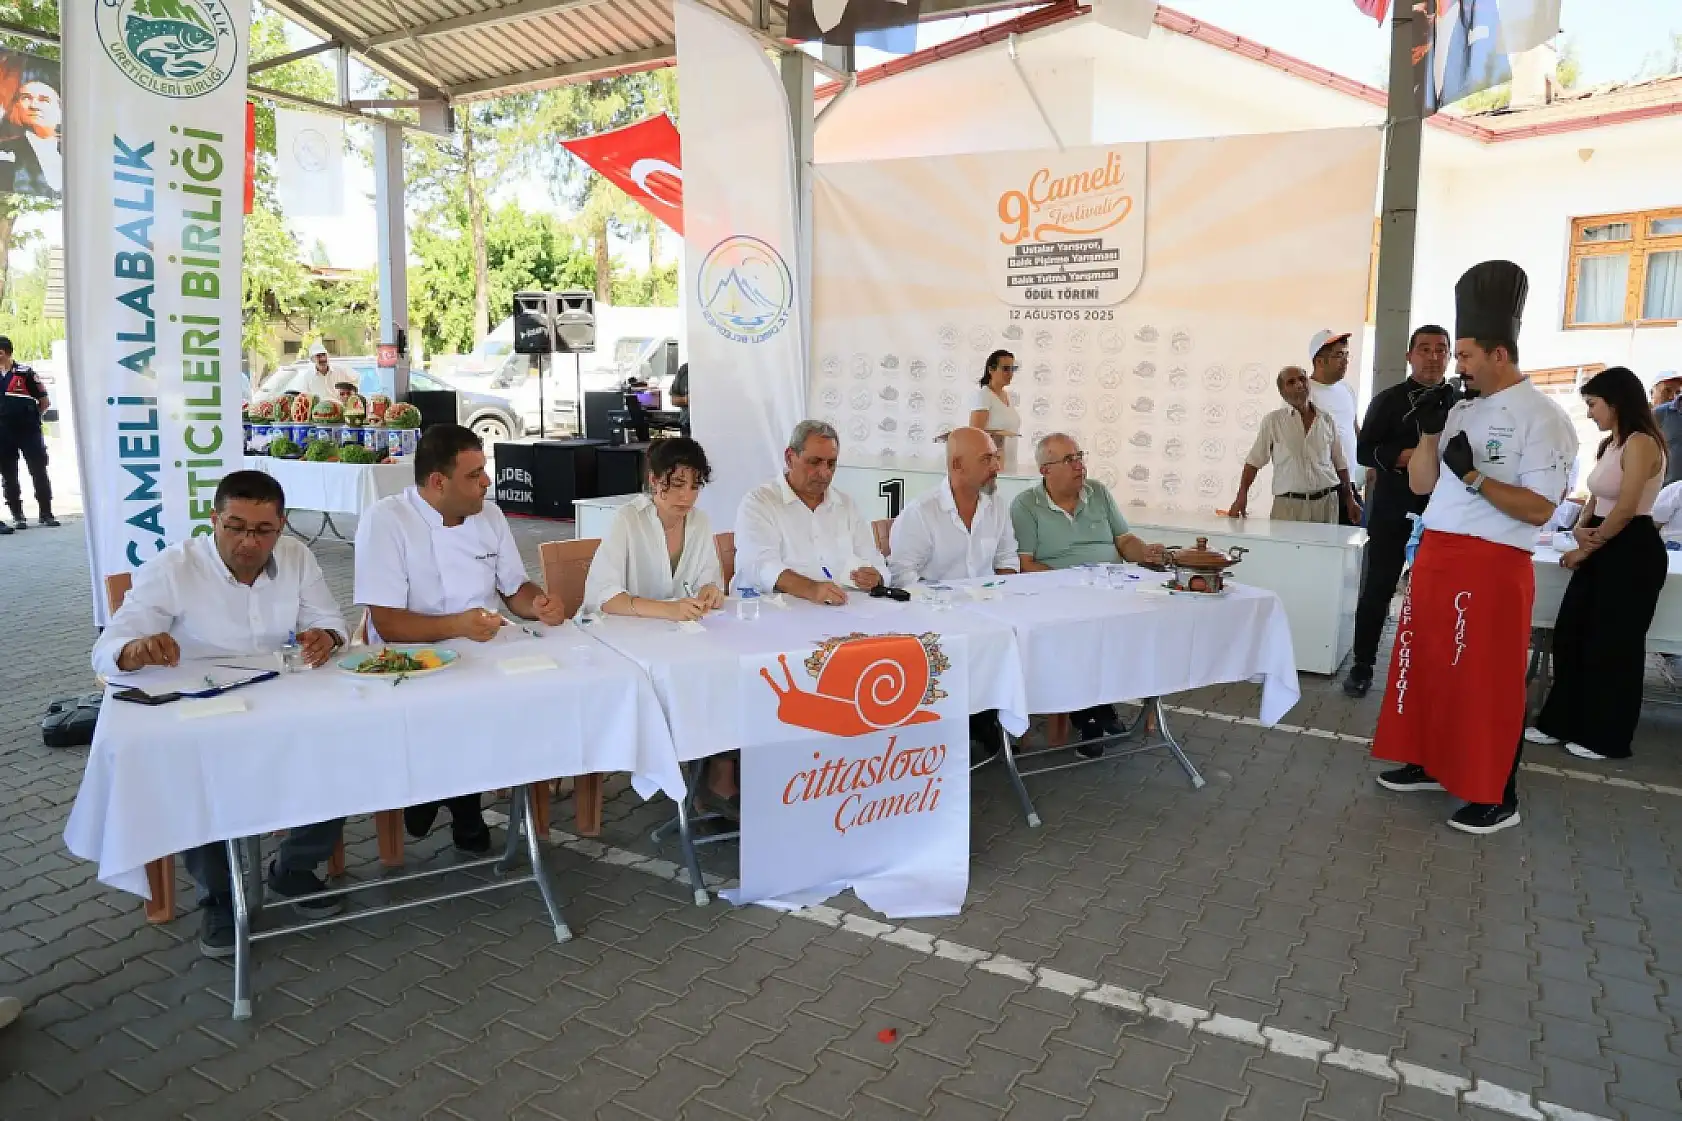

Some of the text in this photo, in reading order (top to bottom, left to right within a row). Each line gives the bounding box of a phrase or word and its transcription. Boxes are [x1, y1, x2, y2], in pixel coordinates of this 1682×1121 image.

[184, 66, 225, 96] BİRLİĞİ
[1028, 151, 1125, 213] Çameli
[167, 125, 225, 300] BİRLİĞİ
[998, 190, 1030, 245] 9.
[113, 133, 158, 379] ALABALIK
[1022, 244, 1055, 255] Ustalar
[1009, 308, 1114, 321] 12 AĞUSTOS 2025
[1024, 285, 1100, 300] ÖDÜL TÖRENİ
[782, 734, 947, 805] cittaslow
[833, 777, 943, 837] Çameli
